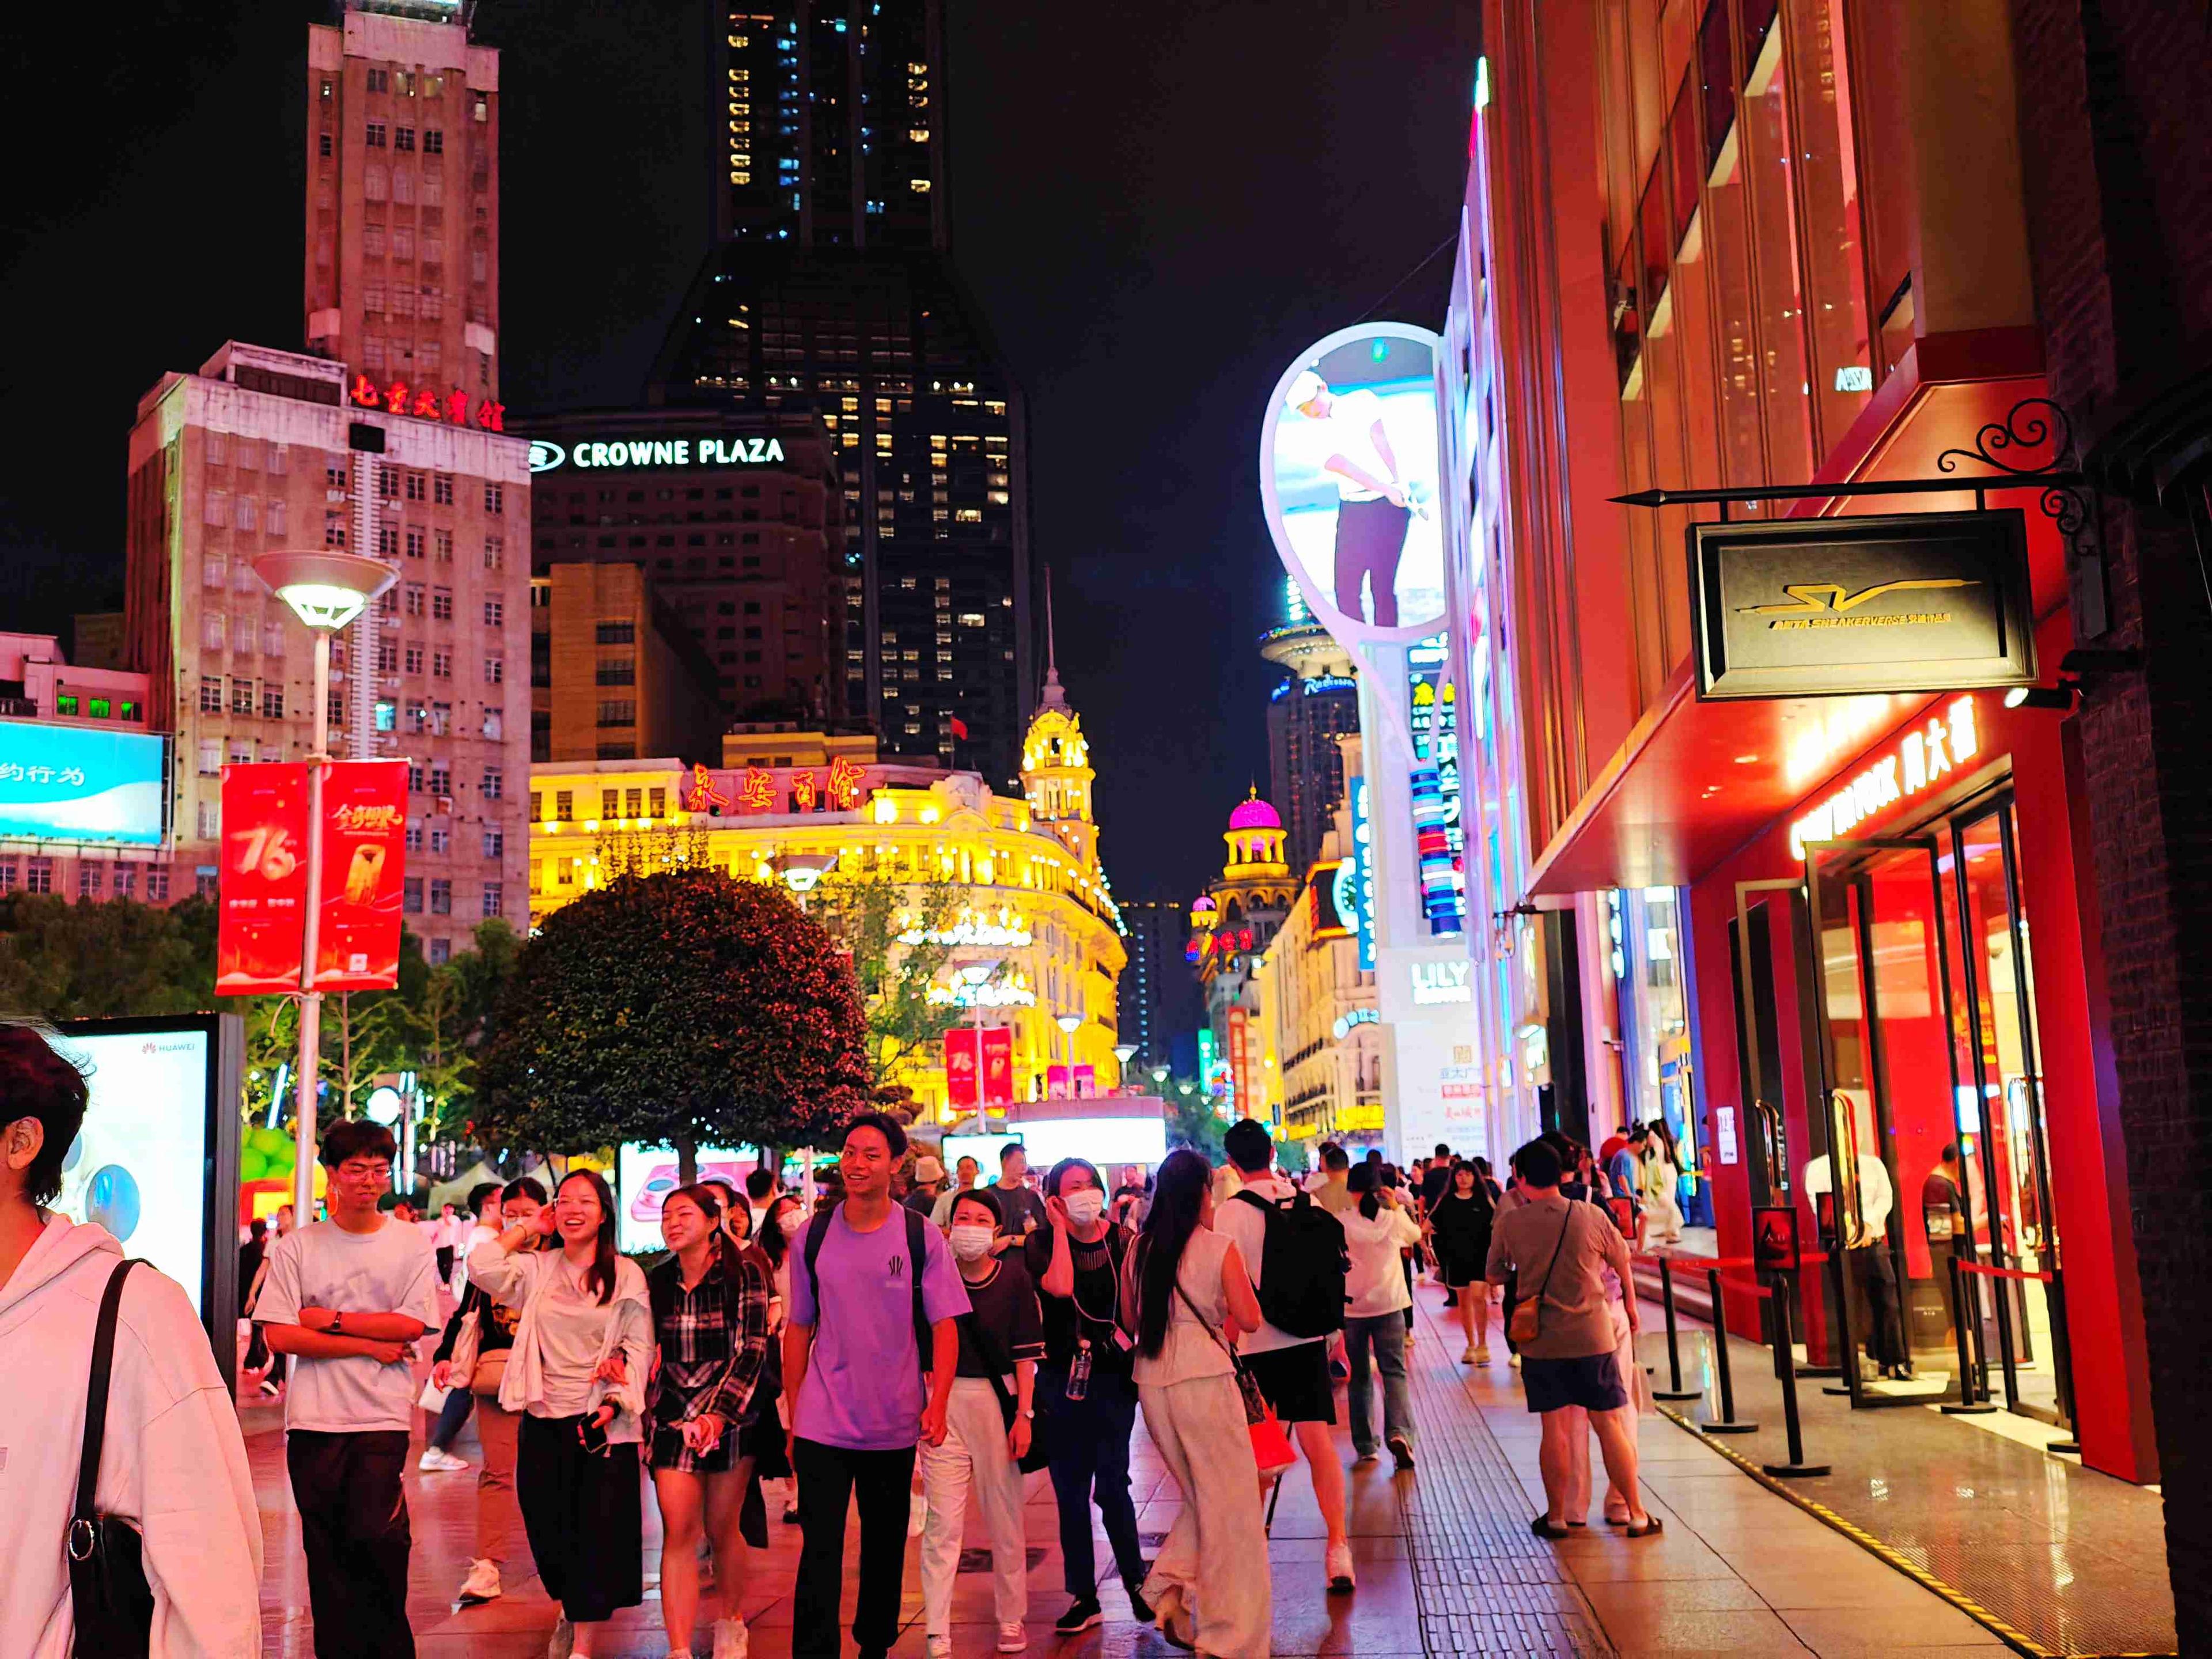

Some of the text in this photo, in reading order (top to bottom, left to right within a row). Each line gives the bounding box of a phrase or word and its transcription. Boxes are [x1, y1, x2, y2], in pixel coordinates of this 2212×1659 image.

[573, 438, 784, 467] CROWNE PLAZA
[1411, 961, 1469, 987] LILY
[158, 1043, 195, 1051] HUAWEI
